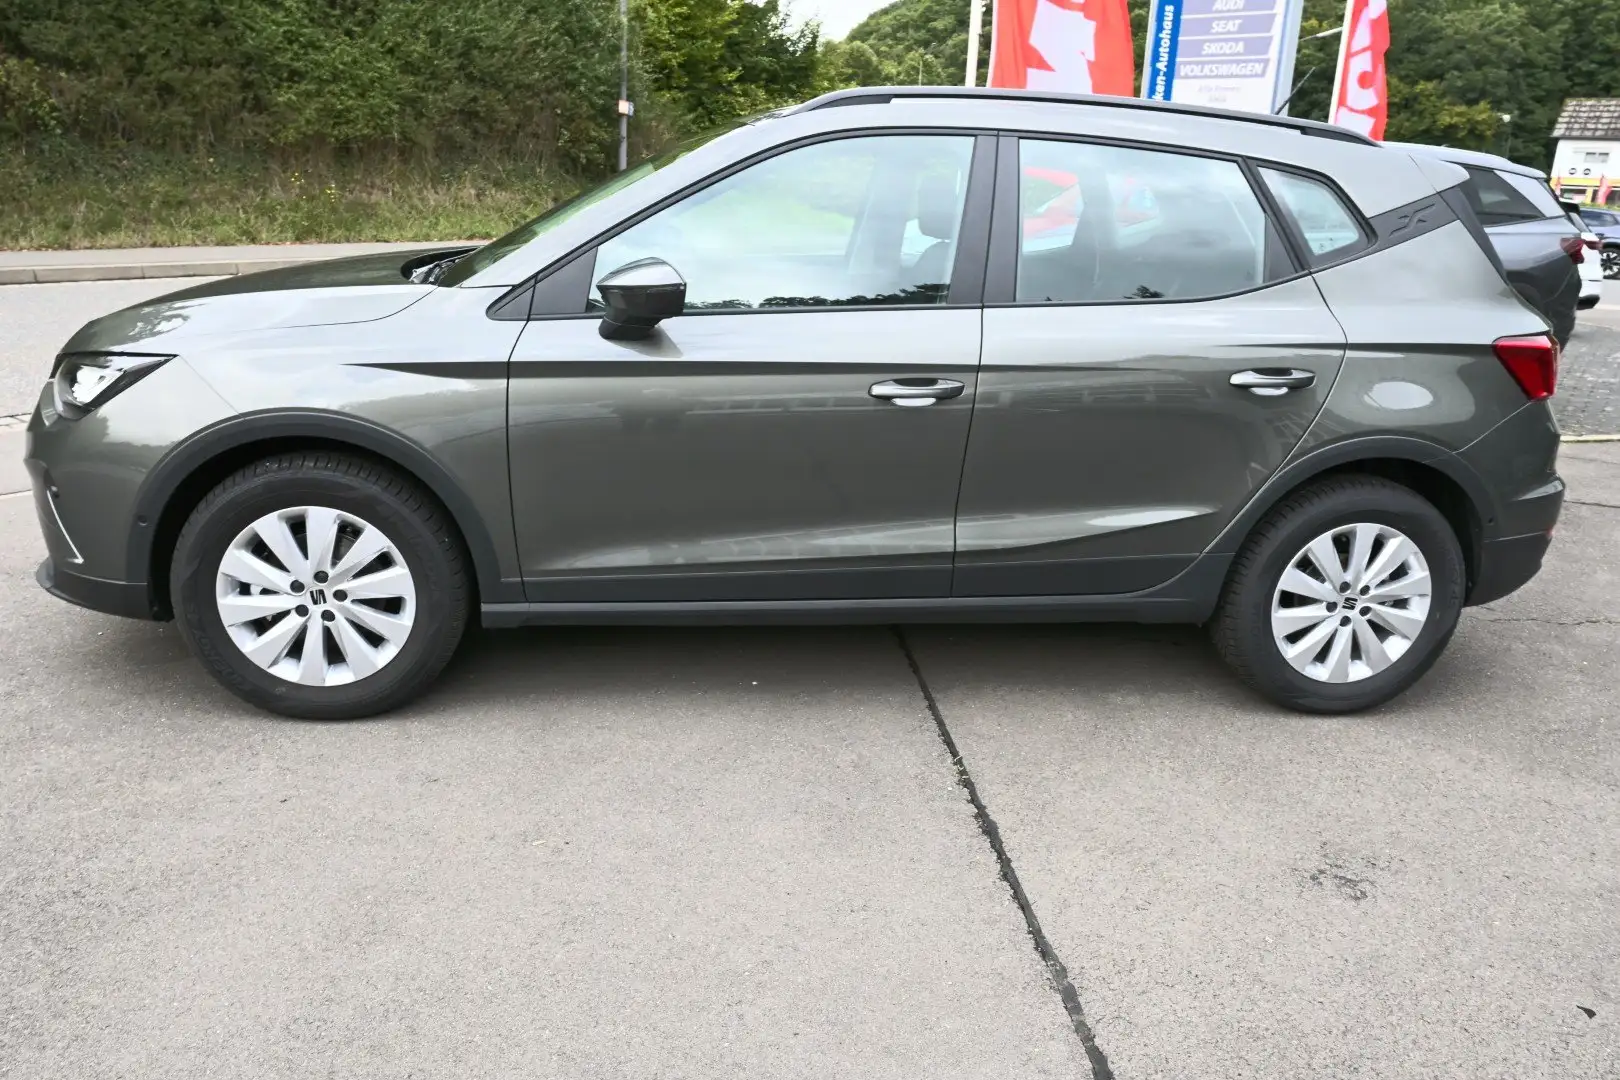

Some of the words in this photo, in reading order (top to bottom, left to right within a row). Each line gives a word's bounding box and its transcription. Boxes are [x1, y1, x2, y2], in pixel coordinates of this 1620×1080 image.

[1211, 0, 1245, 11] AUDI
[1210, 19, 1242, 33] SEAT
[1201, 41, 1244, 55] SKODA
[1179, 62, 1264, 76] VOLKSWAGEN
